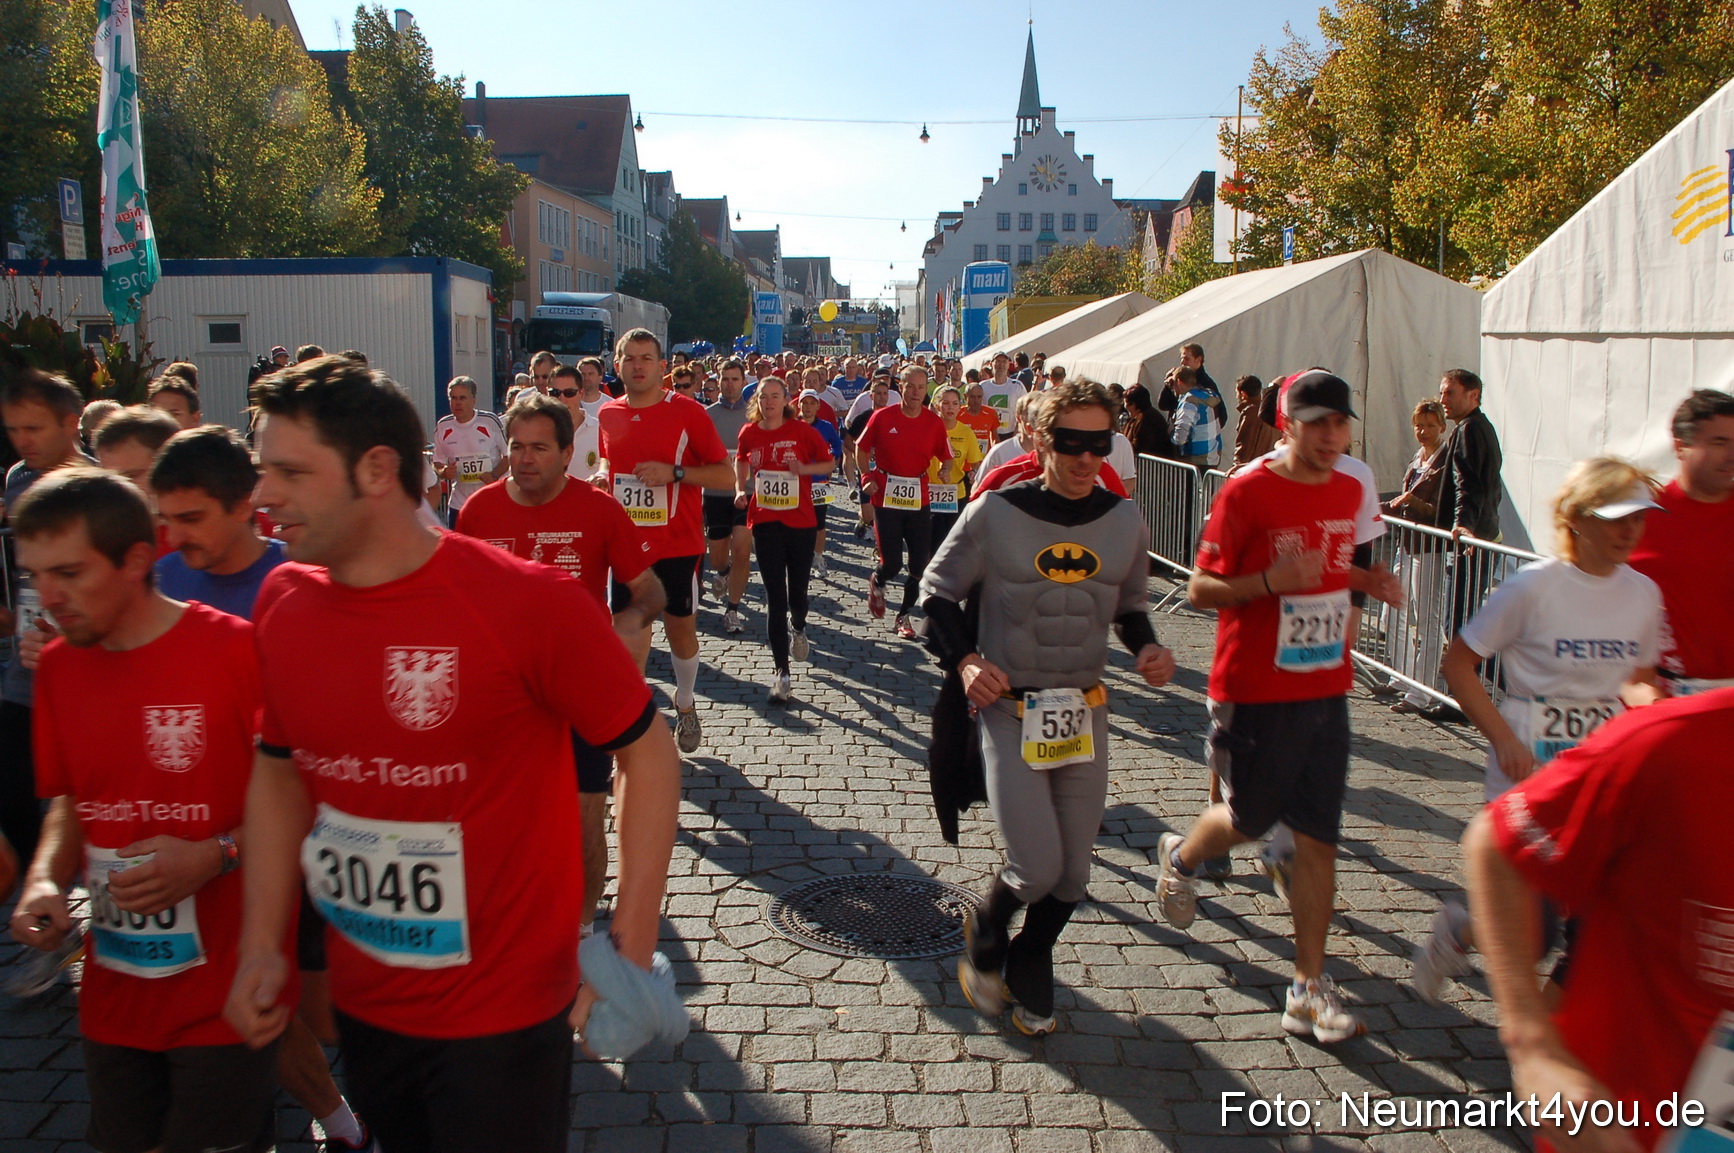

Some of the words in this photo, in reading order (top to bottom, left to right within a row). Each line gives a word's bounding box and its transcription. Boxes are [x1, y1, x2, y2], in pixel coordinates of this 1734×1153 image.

[63, 184, 76, 216] P
[1285, 231, 1292, 256] P
[972, 269, 1006, 289] maxi
[758, 298, 776, 311] axi
[462, 460, 484, 474] 567
[623, 487, 655, 508] 318
[763, 480, 789, 496] 348
[893, 485, 915, 499] 430
[929, 491, 954, 502] 3125
[763, 496, 790, 506] Andrea
[891, 497, 915, 506] Roland
[1042, 709, 1086, 739] 533
[292, 748, 468, 787] Stadt-Team
[75, 799, 211, 822] Stadt-Team
[318, 846, 444, 915] 3046
